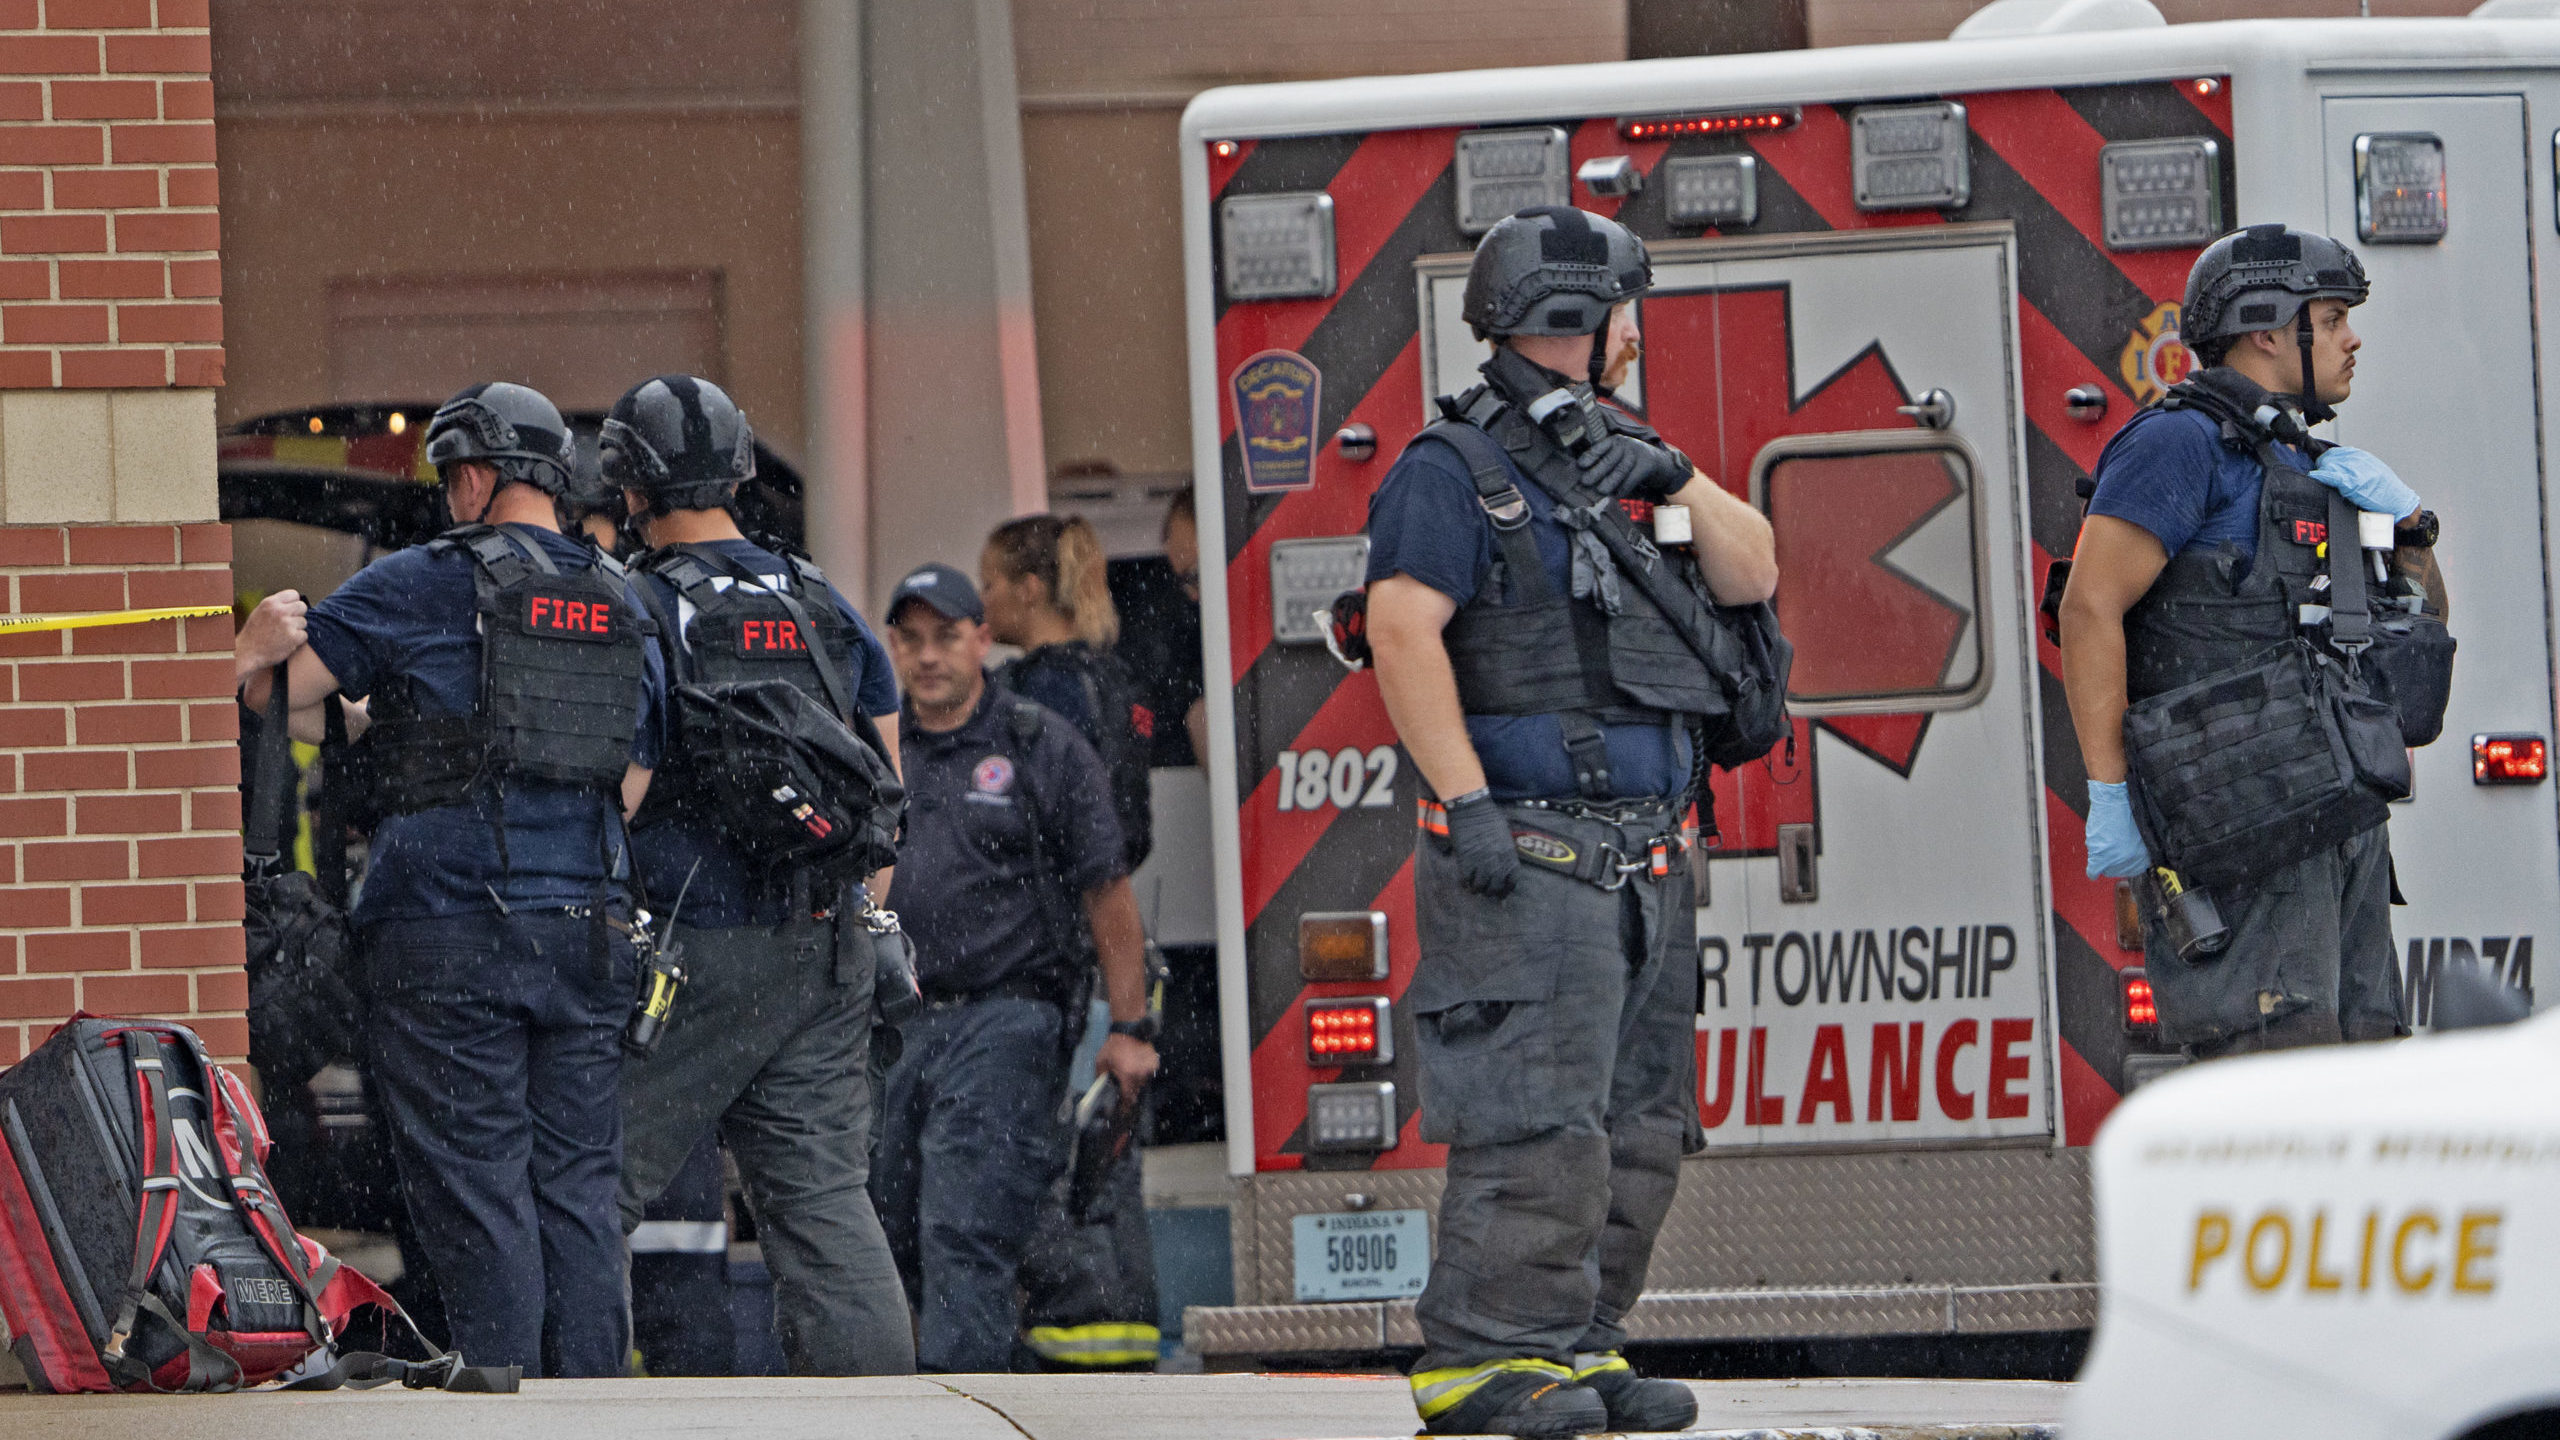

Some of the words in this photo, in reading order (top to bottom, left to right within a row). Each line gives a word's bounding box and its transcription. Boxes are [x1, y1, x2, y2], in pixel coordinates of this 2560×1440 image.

[2162, 311, 2179, 330] A
[2295, 520, 2328, 543] FIR
[531, 597, 609, 633] FIRE
[743, 621, 816, 650] FIR
[1277, 745, 1399, 812] 1802
[1743, 925, 2017, 1006] TOWNSHIP
[1695, 1018, 2034, 1129] ULANCE
[1327, 1233, 1397, 1272] 58906
[2188, 1208, 2503, 1294] POLICE
[235, 1277, 300, 1304] MERE
